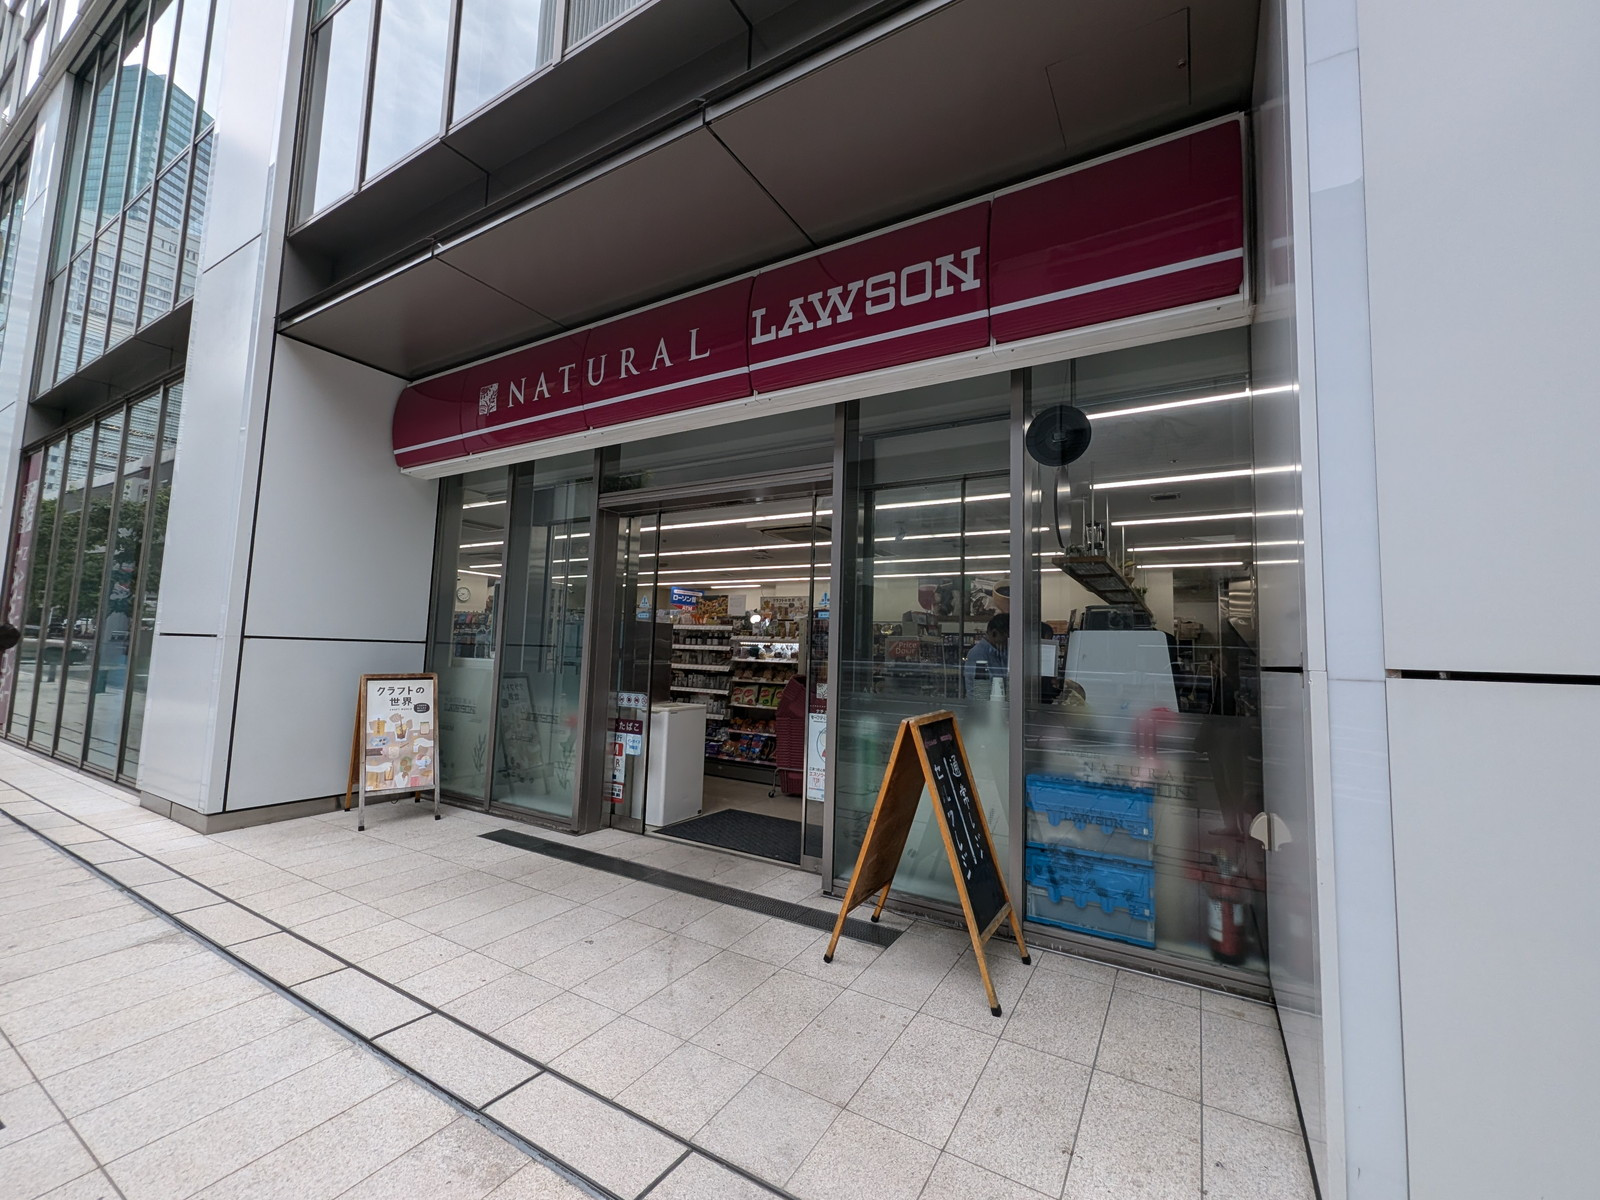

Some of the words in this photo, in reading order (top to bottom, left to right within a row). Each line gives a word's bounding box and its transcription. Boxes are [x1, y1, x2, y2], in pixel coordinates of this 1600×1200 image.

[507, 327, 711, 409] NATURAL
[751, 246, 982, 346] LAWSON
[898, 641, 917, 649] Price
[377, 686, 425, 696] クラフトの
[390, 697, 412, 706] 世界
